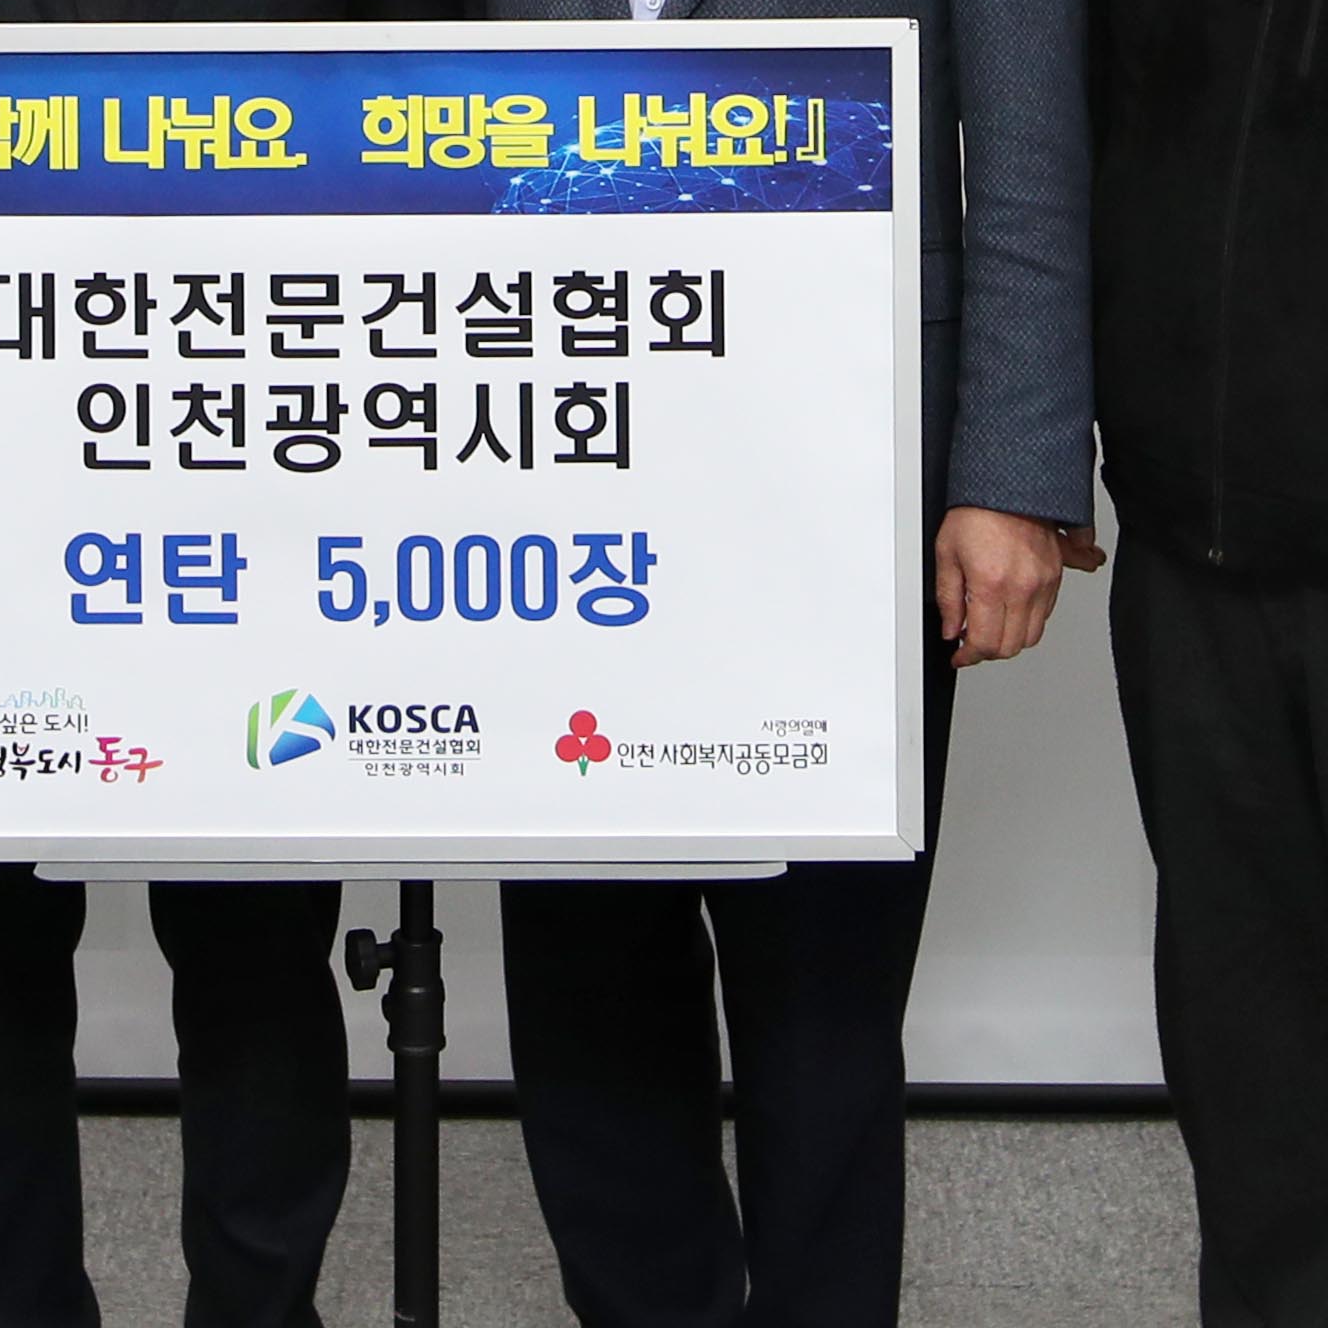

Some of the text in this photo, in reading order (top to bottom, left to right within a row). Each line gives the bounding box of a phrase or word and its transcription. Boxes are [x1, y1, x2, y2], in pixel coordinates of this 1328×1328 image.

[360, 94, 555, 169] 희망을
[75, 381, 631, 474] 인천광역시회
[63, 532, 658, 628] 연탄 5,000장
[0, 713, 38, 735] 싶은
[43, 713, 89, 734] 도시!
[348, 704, 481, 734] KOSCA
[88, 736, 164, 783] 동구
[349, 739, 481, 755] 대한전문건설협회
[617, 742, 828, 775] 인천 사회복지공동모금회
[365, 762, 464, 777] 인천광역시회
